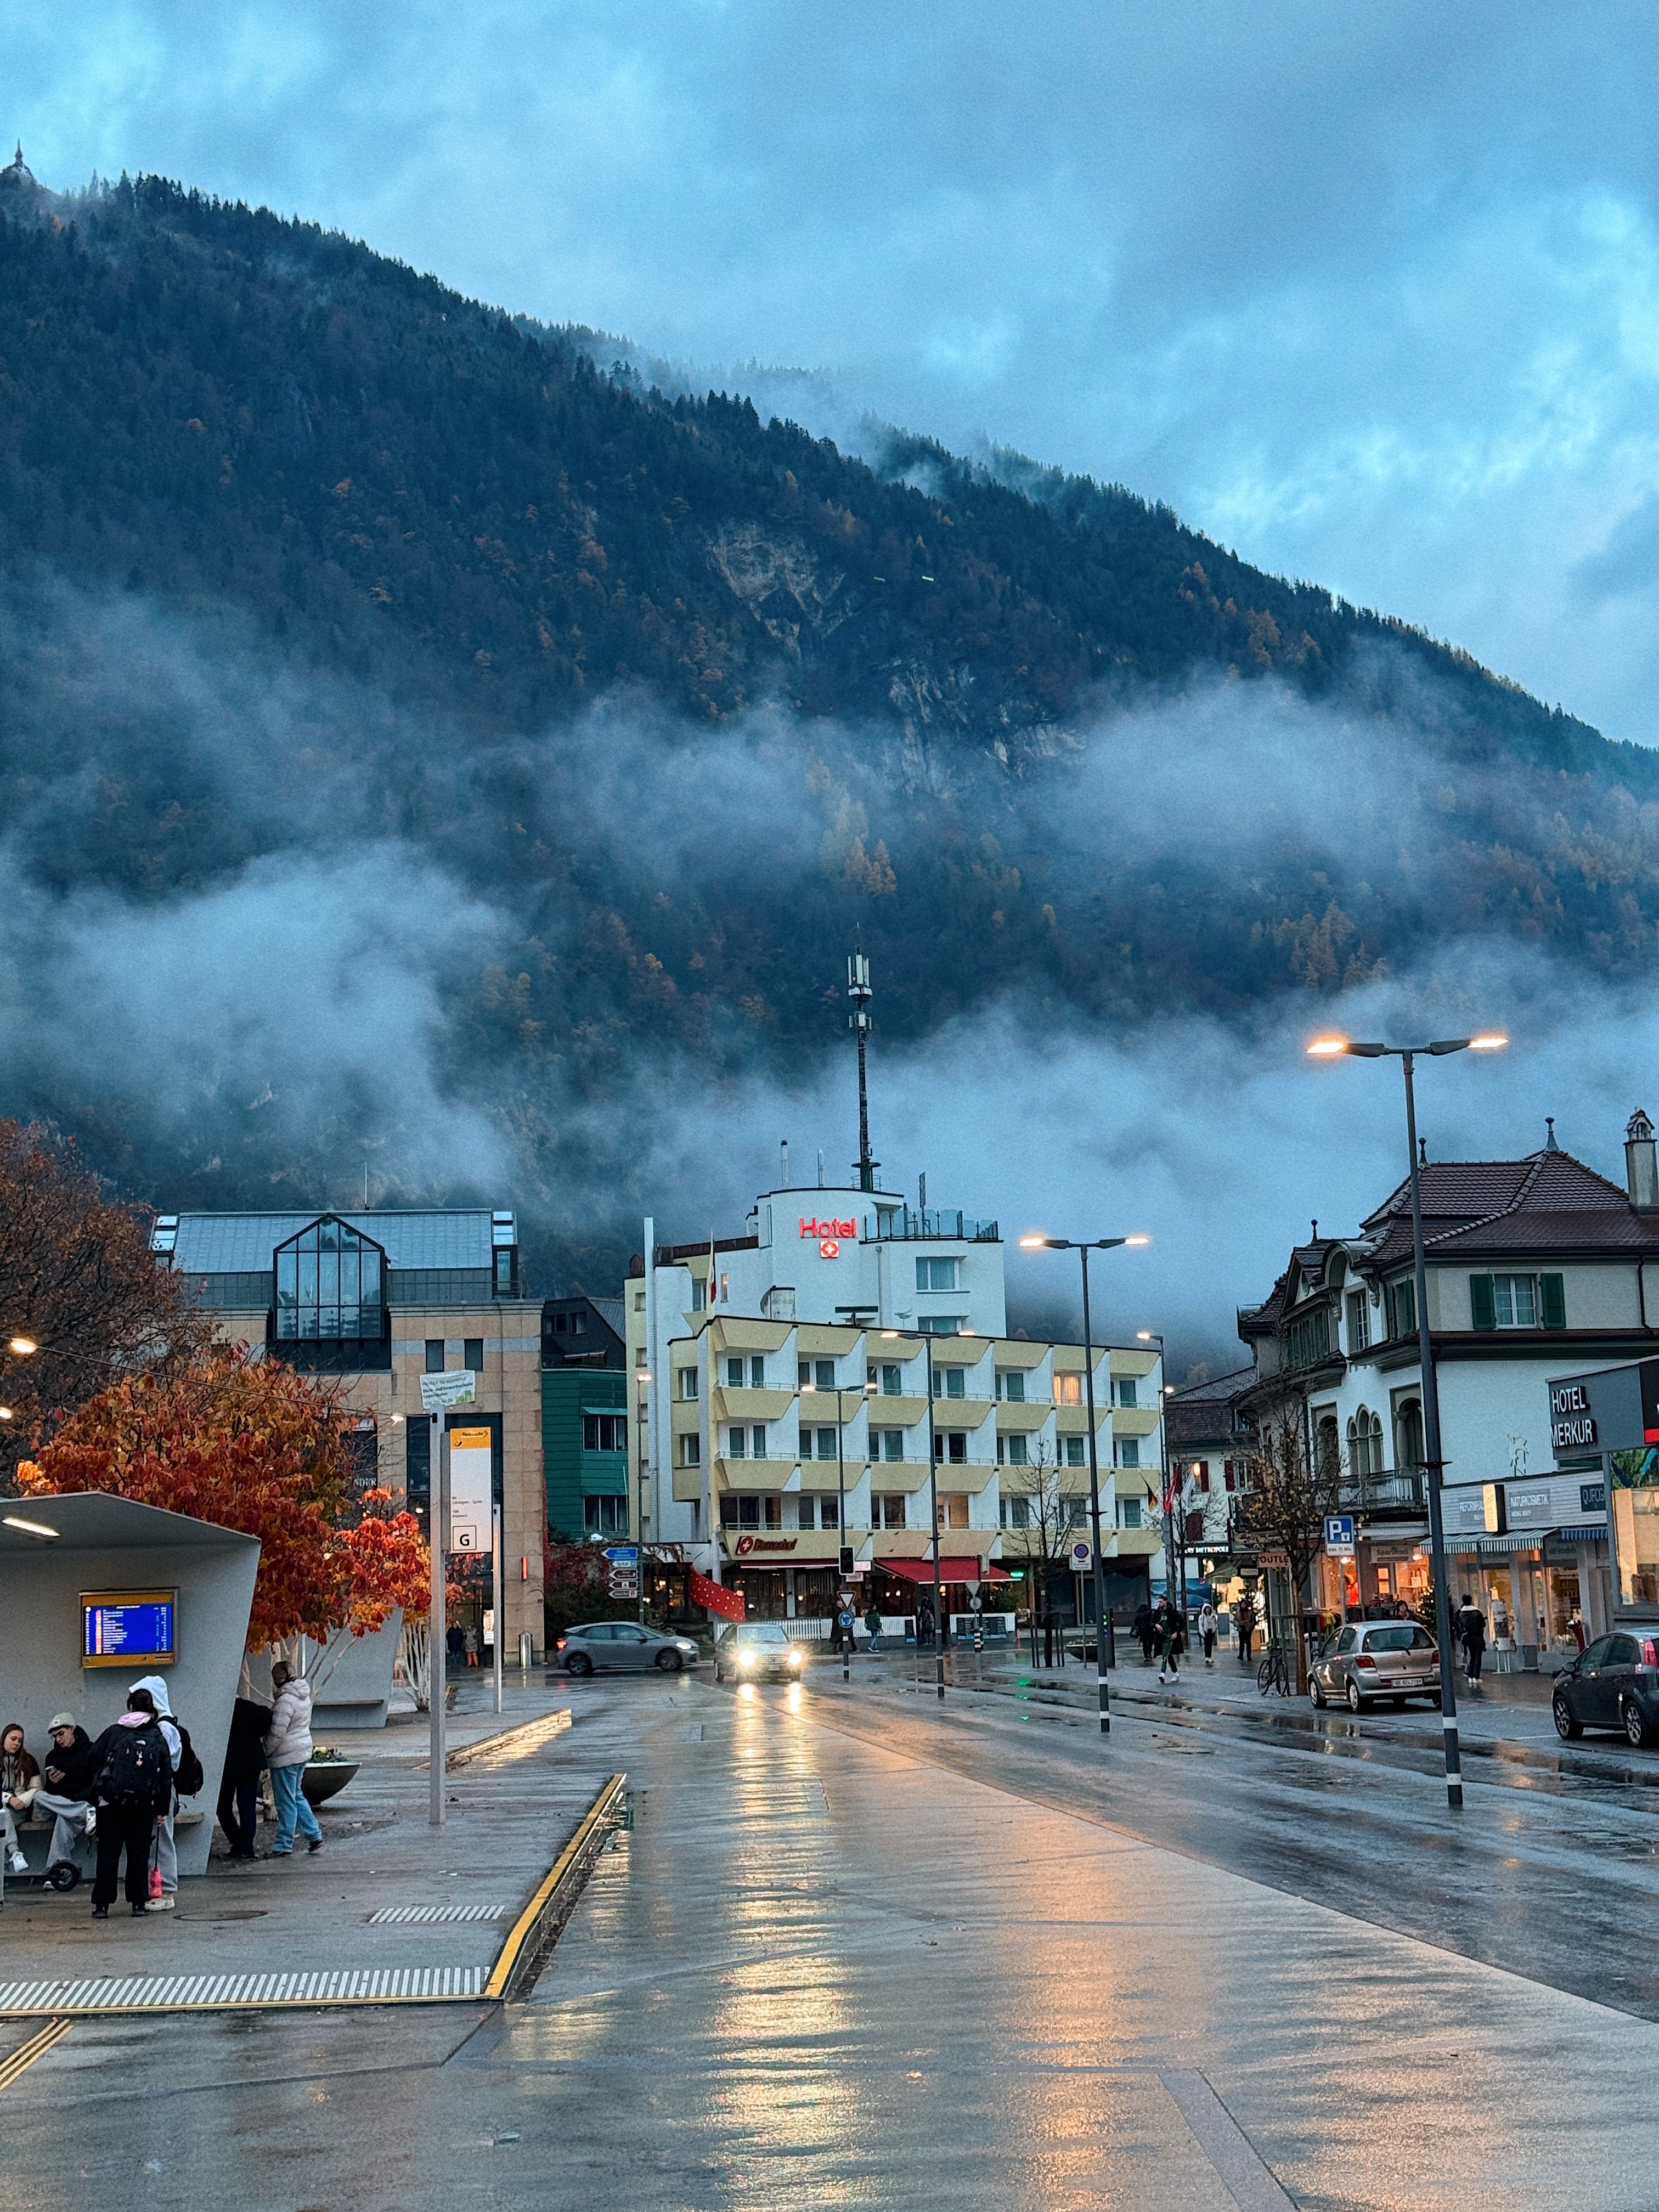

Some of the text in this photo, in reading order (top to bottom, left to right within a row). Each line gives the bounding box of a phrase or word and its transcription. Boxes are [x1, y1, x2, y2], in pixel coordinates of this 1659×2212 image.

[799, 1217, 856, 1237] Hotel
[1551, 1386, 1586, 1414] HOTEL
[1549, 1419, 1593, 1448] MERKUR
[459, 1534, 470, 1547] G
[1329, 1520, 1342, 1541] P
[1259, 1555, 1289, 1564] OUTLE
